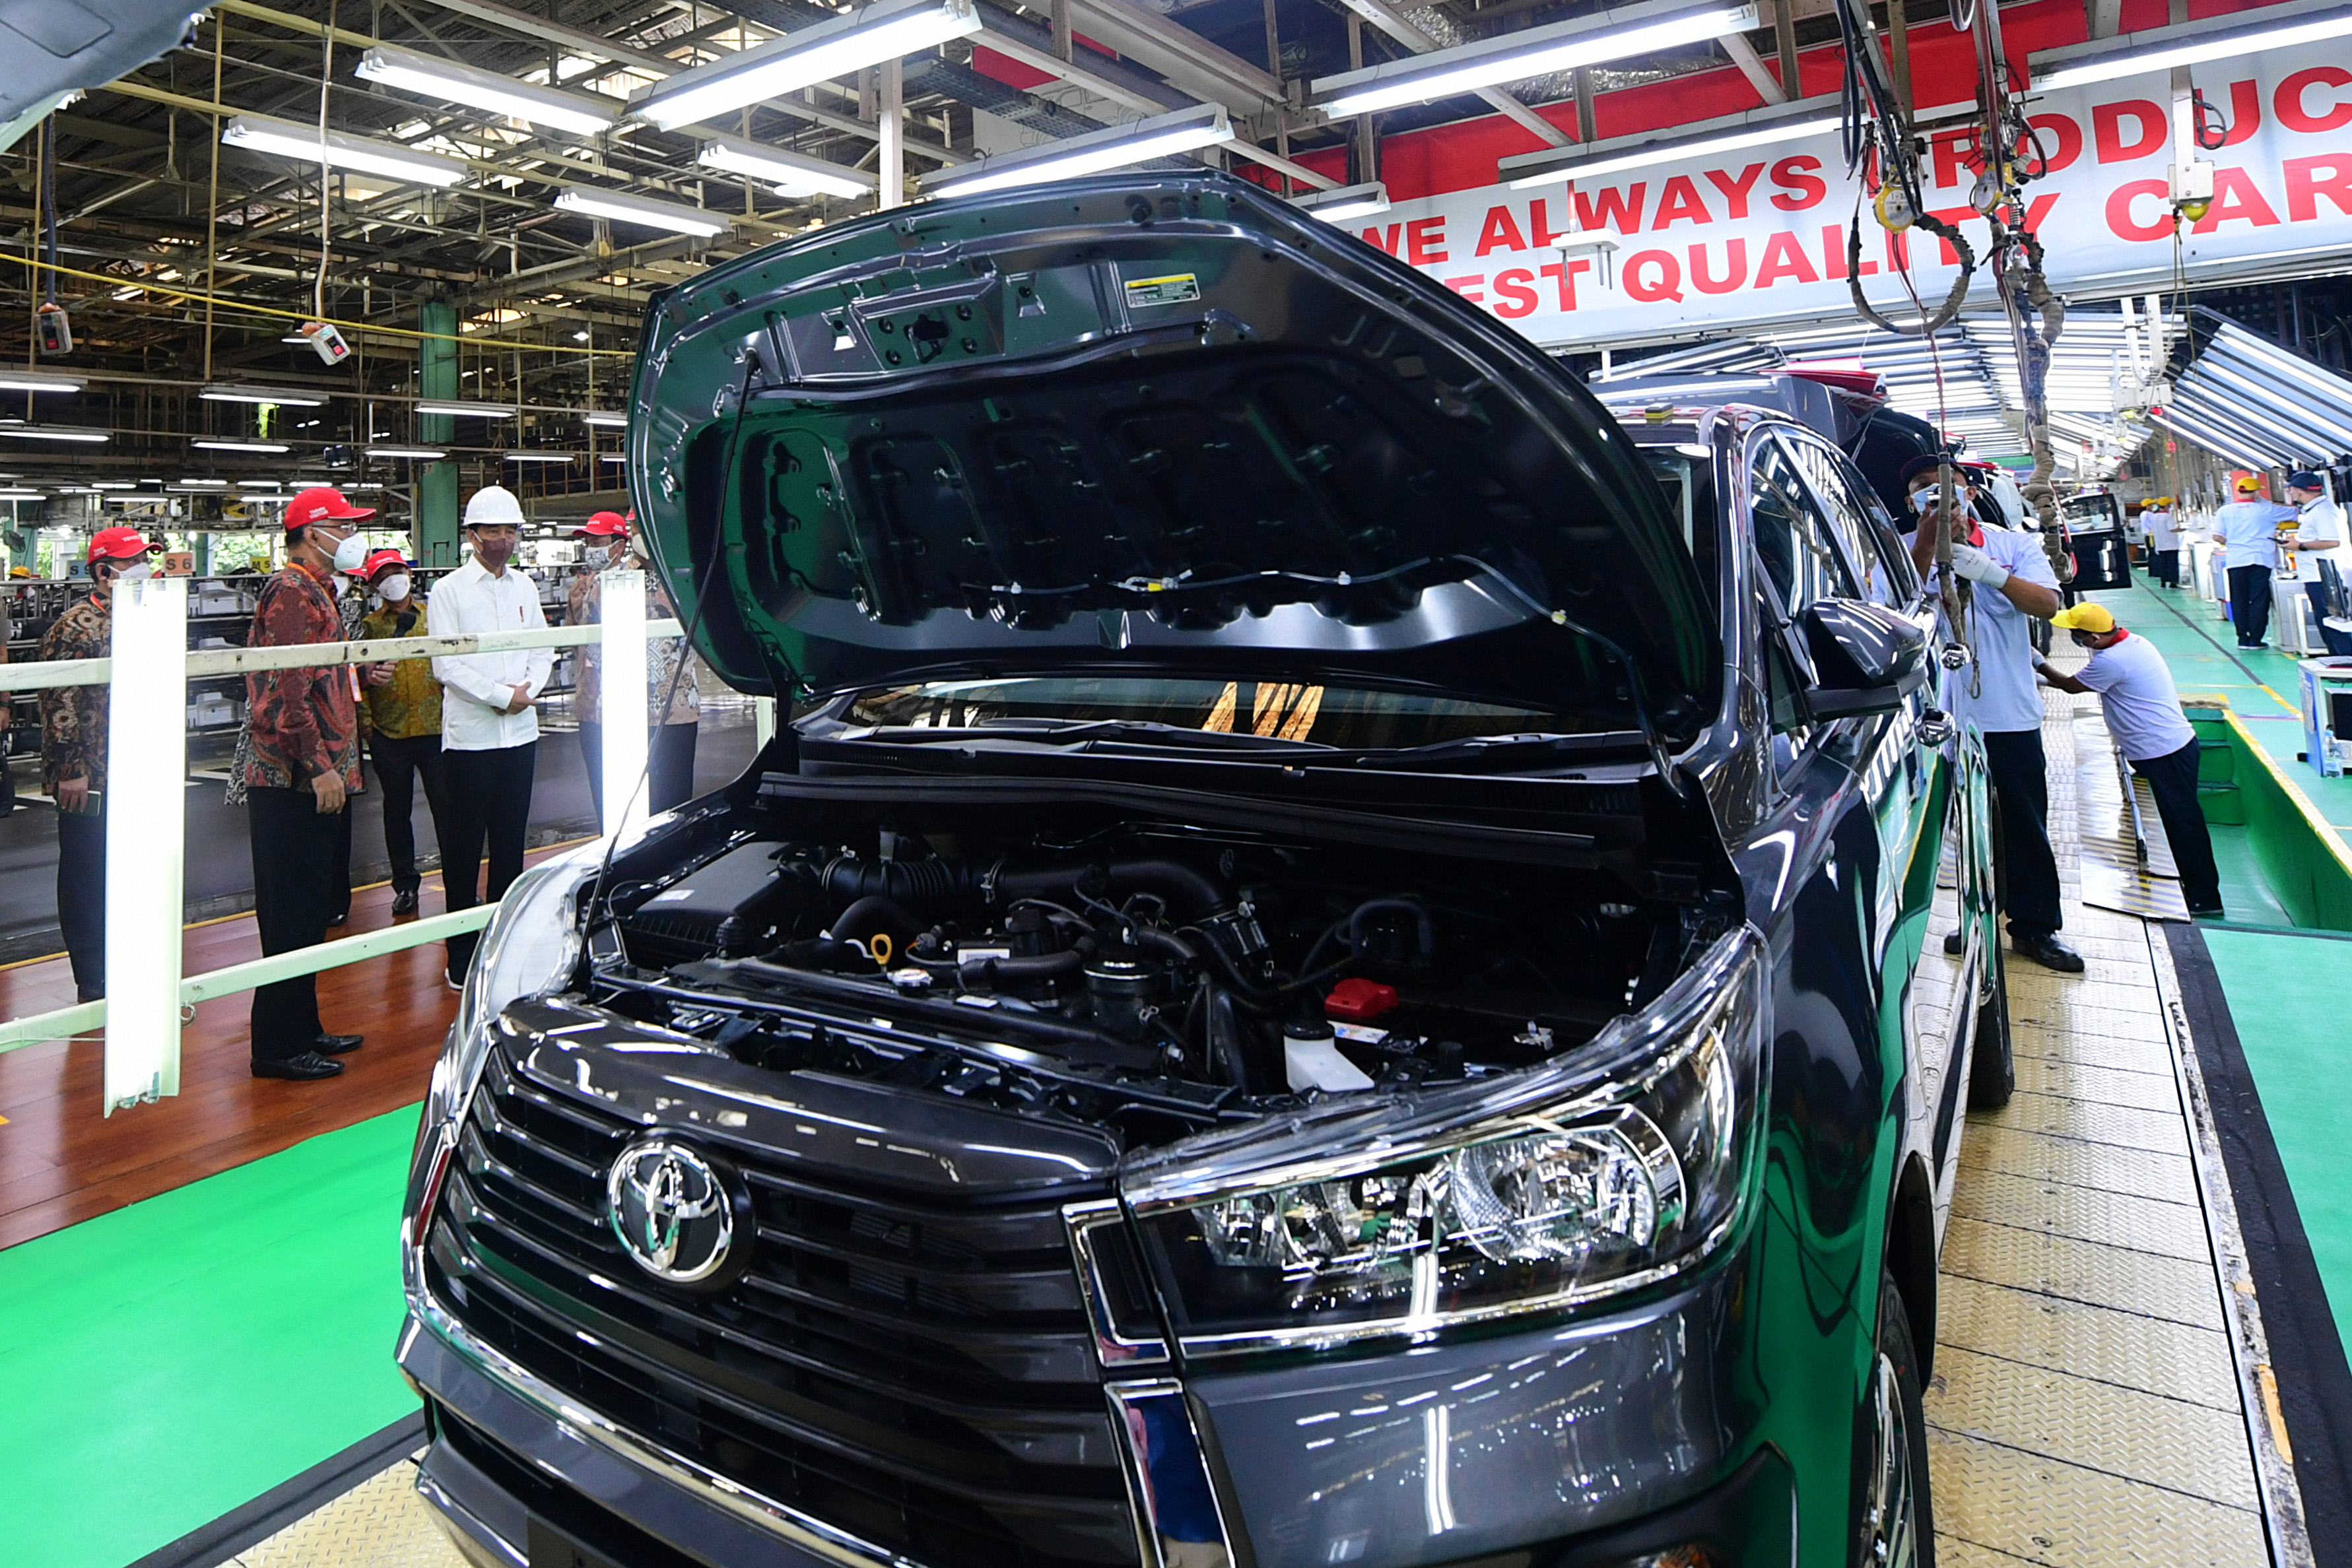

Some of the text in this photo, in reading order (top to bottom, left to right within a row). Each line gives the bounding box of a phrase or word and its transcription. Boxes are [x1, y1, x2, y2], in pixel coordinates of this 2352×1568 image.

[1474, 154, 1827, 257] ALWAYS
[1866, 66, 2352, 198] RODUC
[1444, 259, 1590, 319] EST
[69, 565, 79, 575] S
[166, 558, 192, 571] S 6
[252, 560, 271, 570] M 5
